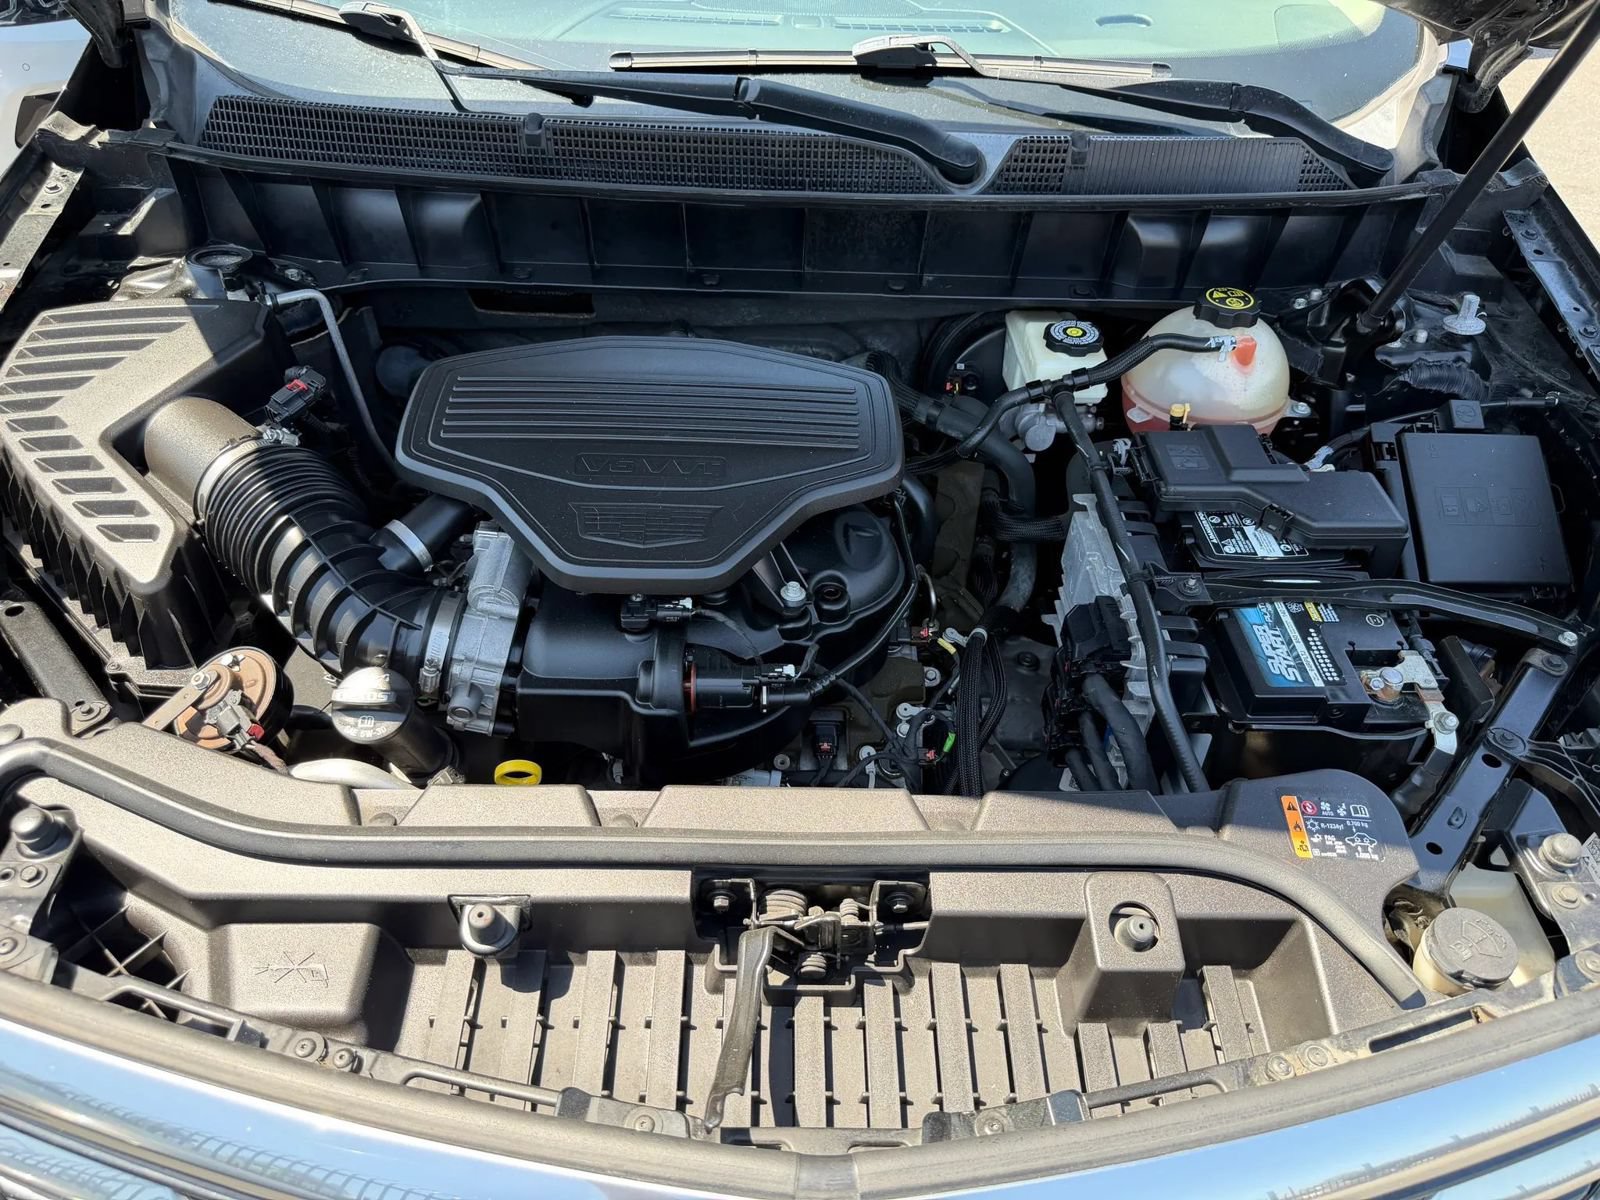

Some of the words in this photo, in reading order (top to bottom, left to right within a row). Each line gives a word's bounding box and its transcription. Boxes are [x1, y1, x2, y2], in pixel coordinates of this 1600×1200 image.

[1252, 624, 1281, 675] SUPER
[1268, 626, 1304, 682] START
[359, 726, 387, 738] 5W-30
